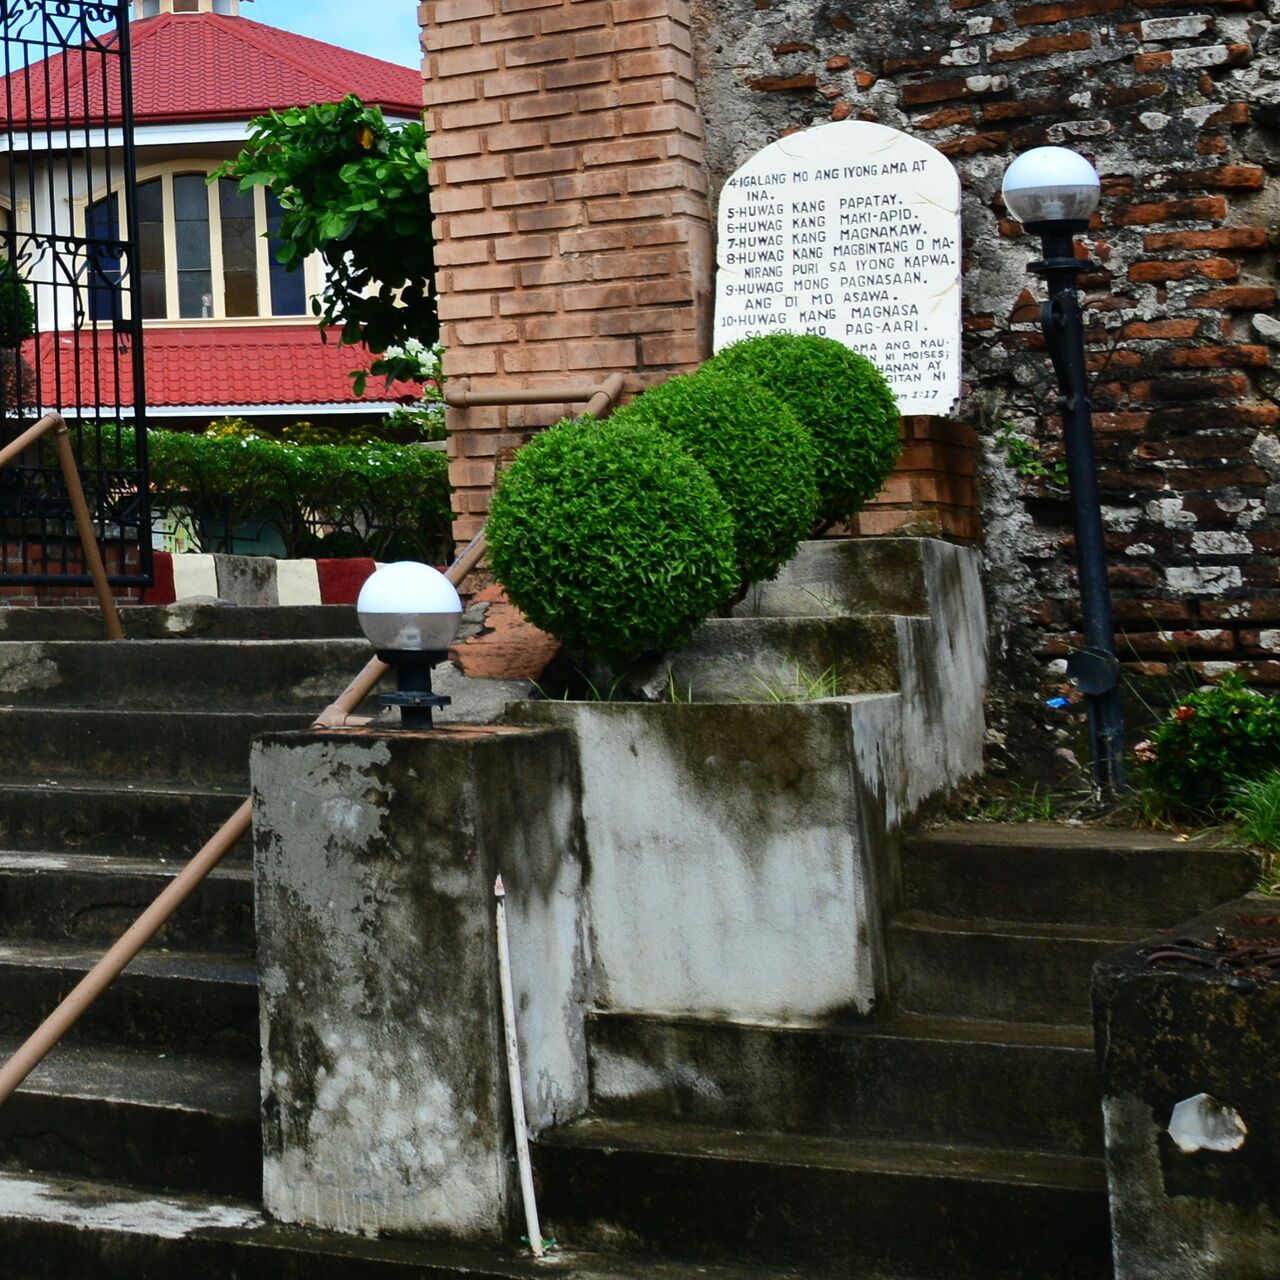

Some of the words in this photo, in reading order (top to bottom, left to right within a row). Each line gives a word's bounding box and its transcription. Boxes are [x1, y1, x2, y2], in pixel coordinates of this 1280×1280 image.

[793, 171, 808, 182] MO
[815, 169, 839, 180] ANG
[844, 165, 877, 178] IYONG
[881, 162, 907, 175] AMA
[912, 160, 927, 172] AT
[747, 190, 774, 201] INA.
[792, 200, 825, 213] KANG
[840, 194, 903, 209] PAPATAY.
[792, 216, 826, 229] KANG
[840, 209, 918, 225] MAKI-APID.
[792, 231, 826, 244] KANG
[840, 223, 927, 241] MAGNAKAW.
[793, 247, 823, 260] KANG
[834, 241, 908, 256] MAGBINTANG
[916, 239, 924, 250] O
[932, 237, 954, 250] MA-
[745, 266, 783, 279] NIRANG
[793, 263, 818, 275] PURI
[829, 261, 846, 272] SA
[856, 258, 895, 271] IYONG
[904, 254, 955, 268] KAPWA.
[794, 278, 829, 291] MONG
[840, 272, 927, 287] PAGNASAAN.
[745, 297, 771, 310] ANG
[785, 296, 798, 307] DI
[812, 293, 833, 305] MO
[800, 309, 836, 322] KANG
[852, 304, 918, 319] MAGNASA
[886, 340, 910, 350] ANG
[928, 361, 941, 370] AY
[933, 371, 945, 380] NI
[911, 390, 938, 399] 1:17
